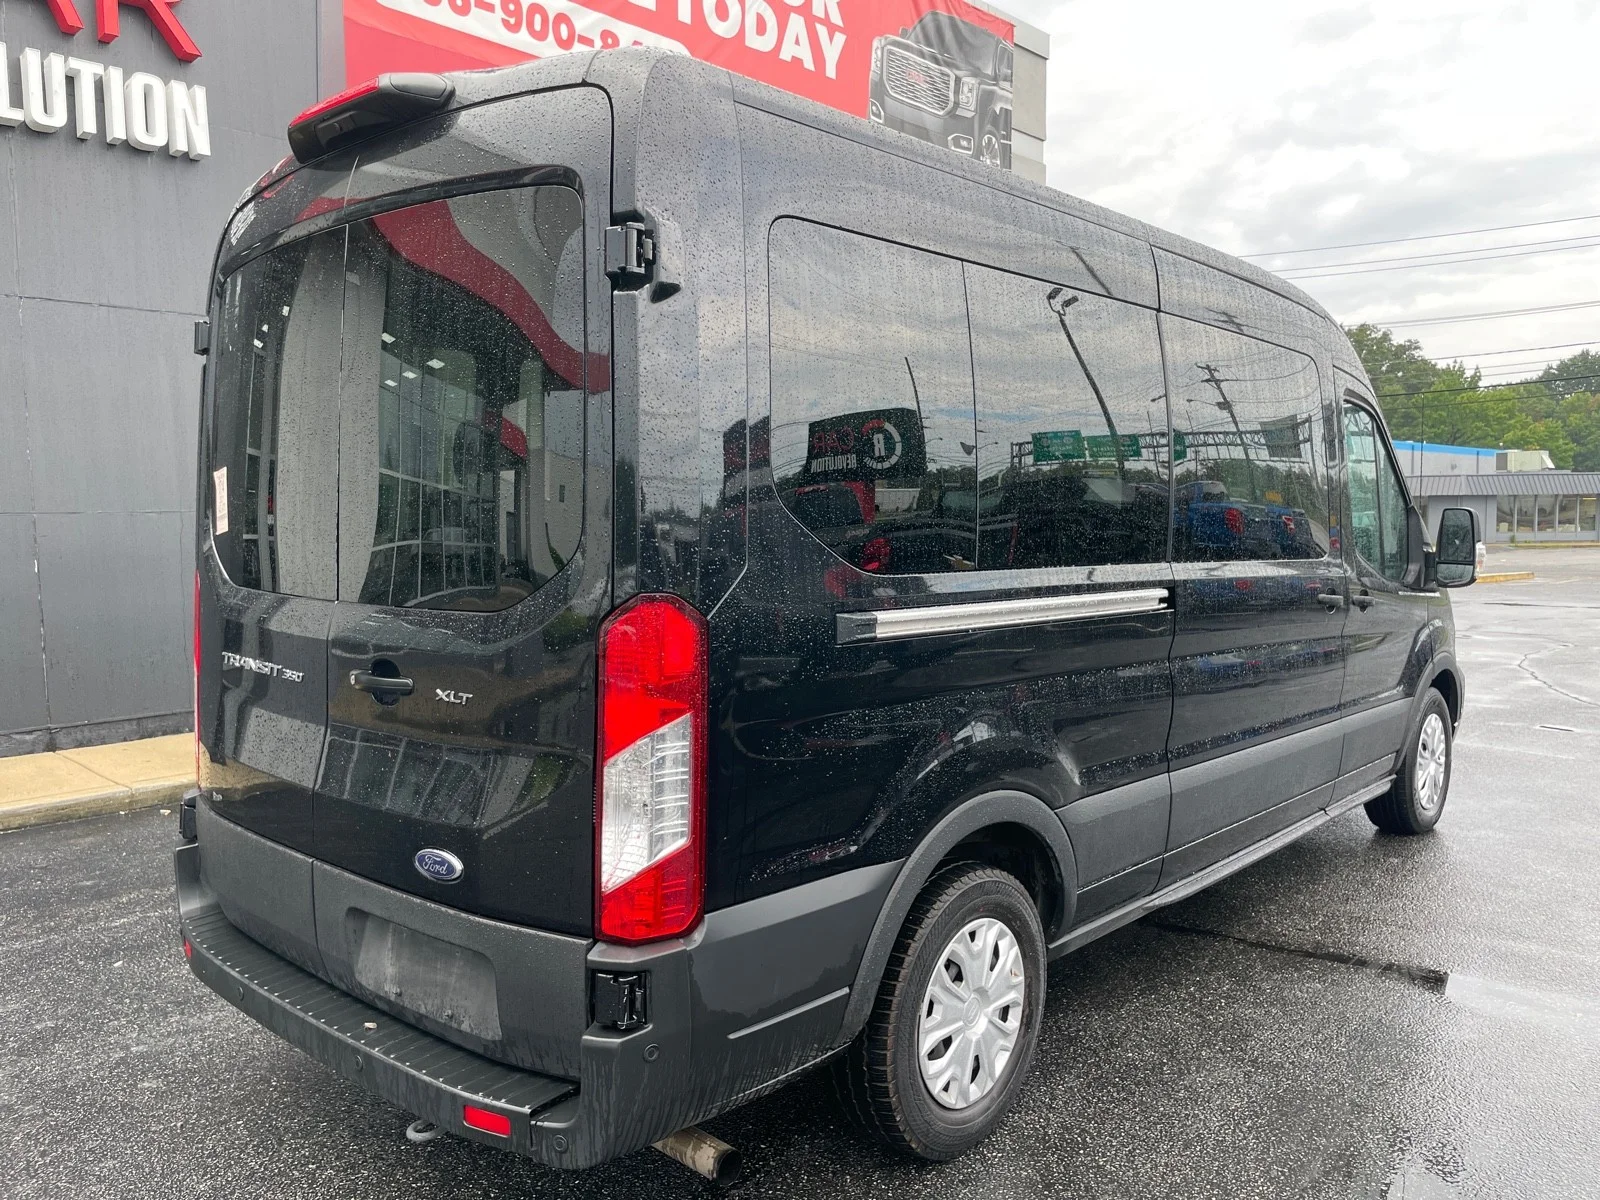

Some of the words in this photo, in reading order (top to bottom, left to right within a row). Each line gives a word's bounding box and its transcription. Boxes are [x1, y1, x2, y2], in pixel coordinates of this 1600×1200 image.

[222, 651, 282, 677] TRANSIT
[282, 668, 304, 682] 350
[435, 688, 473, 704] XLT
[423, 854, 448, 875] Ford
